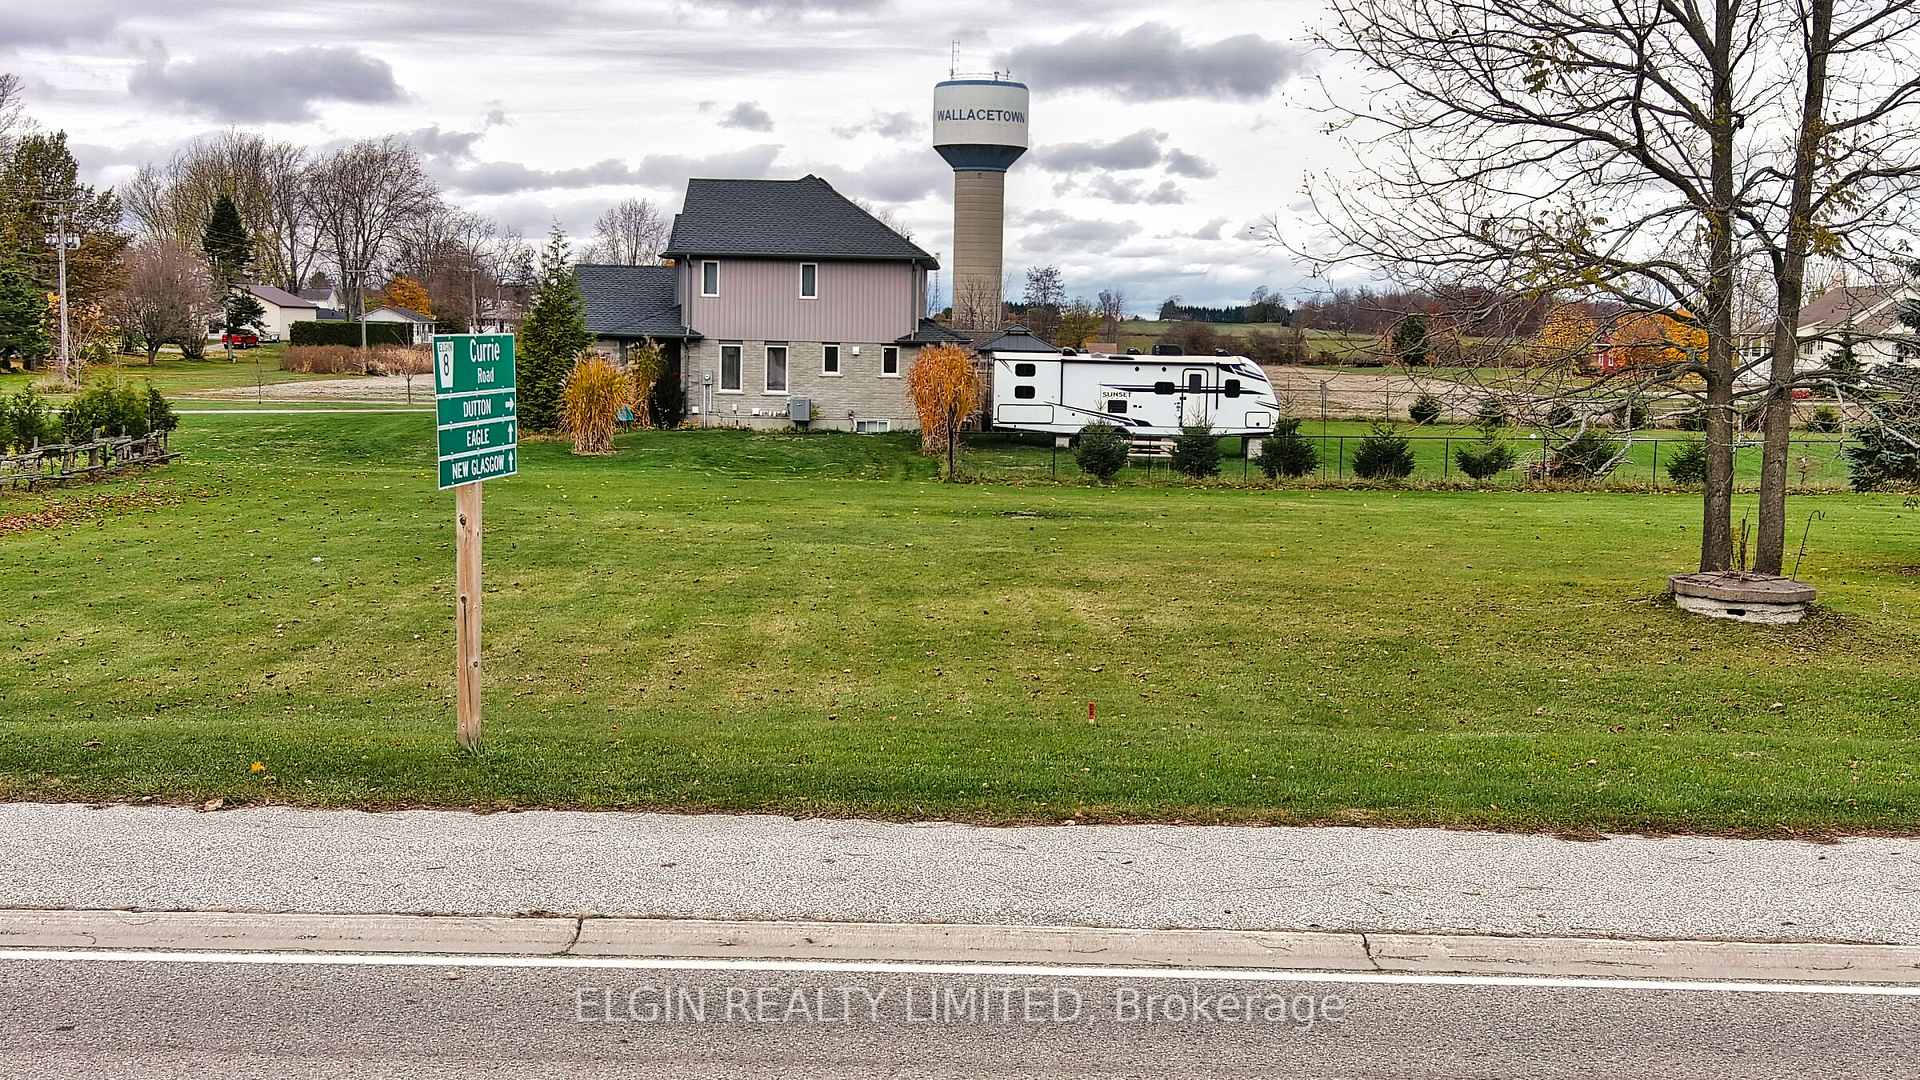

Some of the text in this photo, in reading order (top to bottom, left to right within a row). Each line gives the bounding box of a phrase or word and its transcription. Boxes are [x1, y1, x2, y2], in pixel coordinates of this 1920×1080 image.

[937, 109, 1025, 123] WALLACETOWN
[470, 338, 500, 362] Currie
[443, 353, 450, 376] 8
[477, 367, 494, 384] Road
[463, 398, 491, 417] DUTTON
[466, 428, 490, 447] EAGLE
[452, 455, 505, 479] NEW GLASGOW
